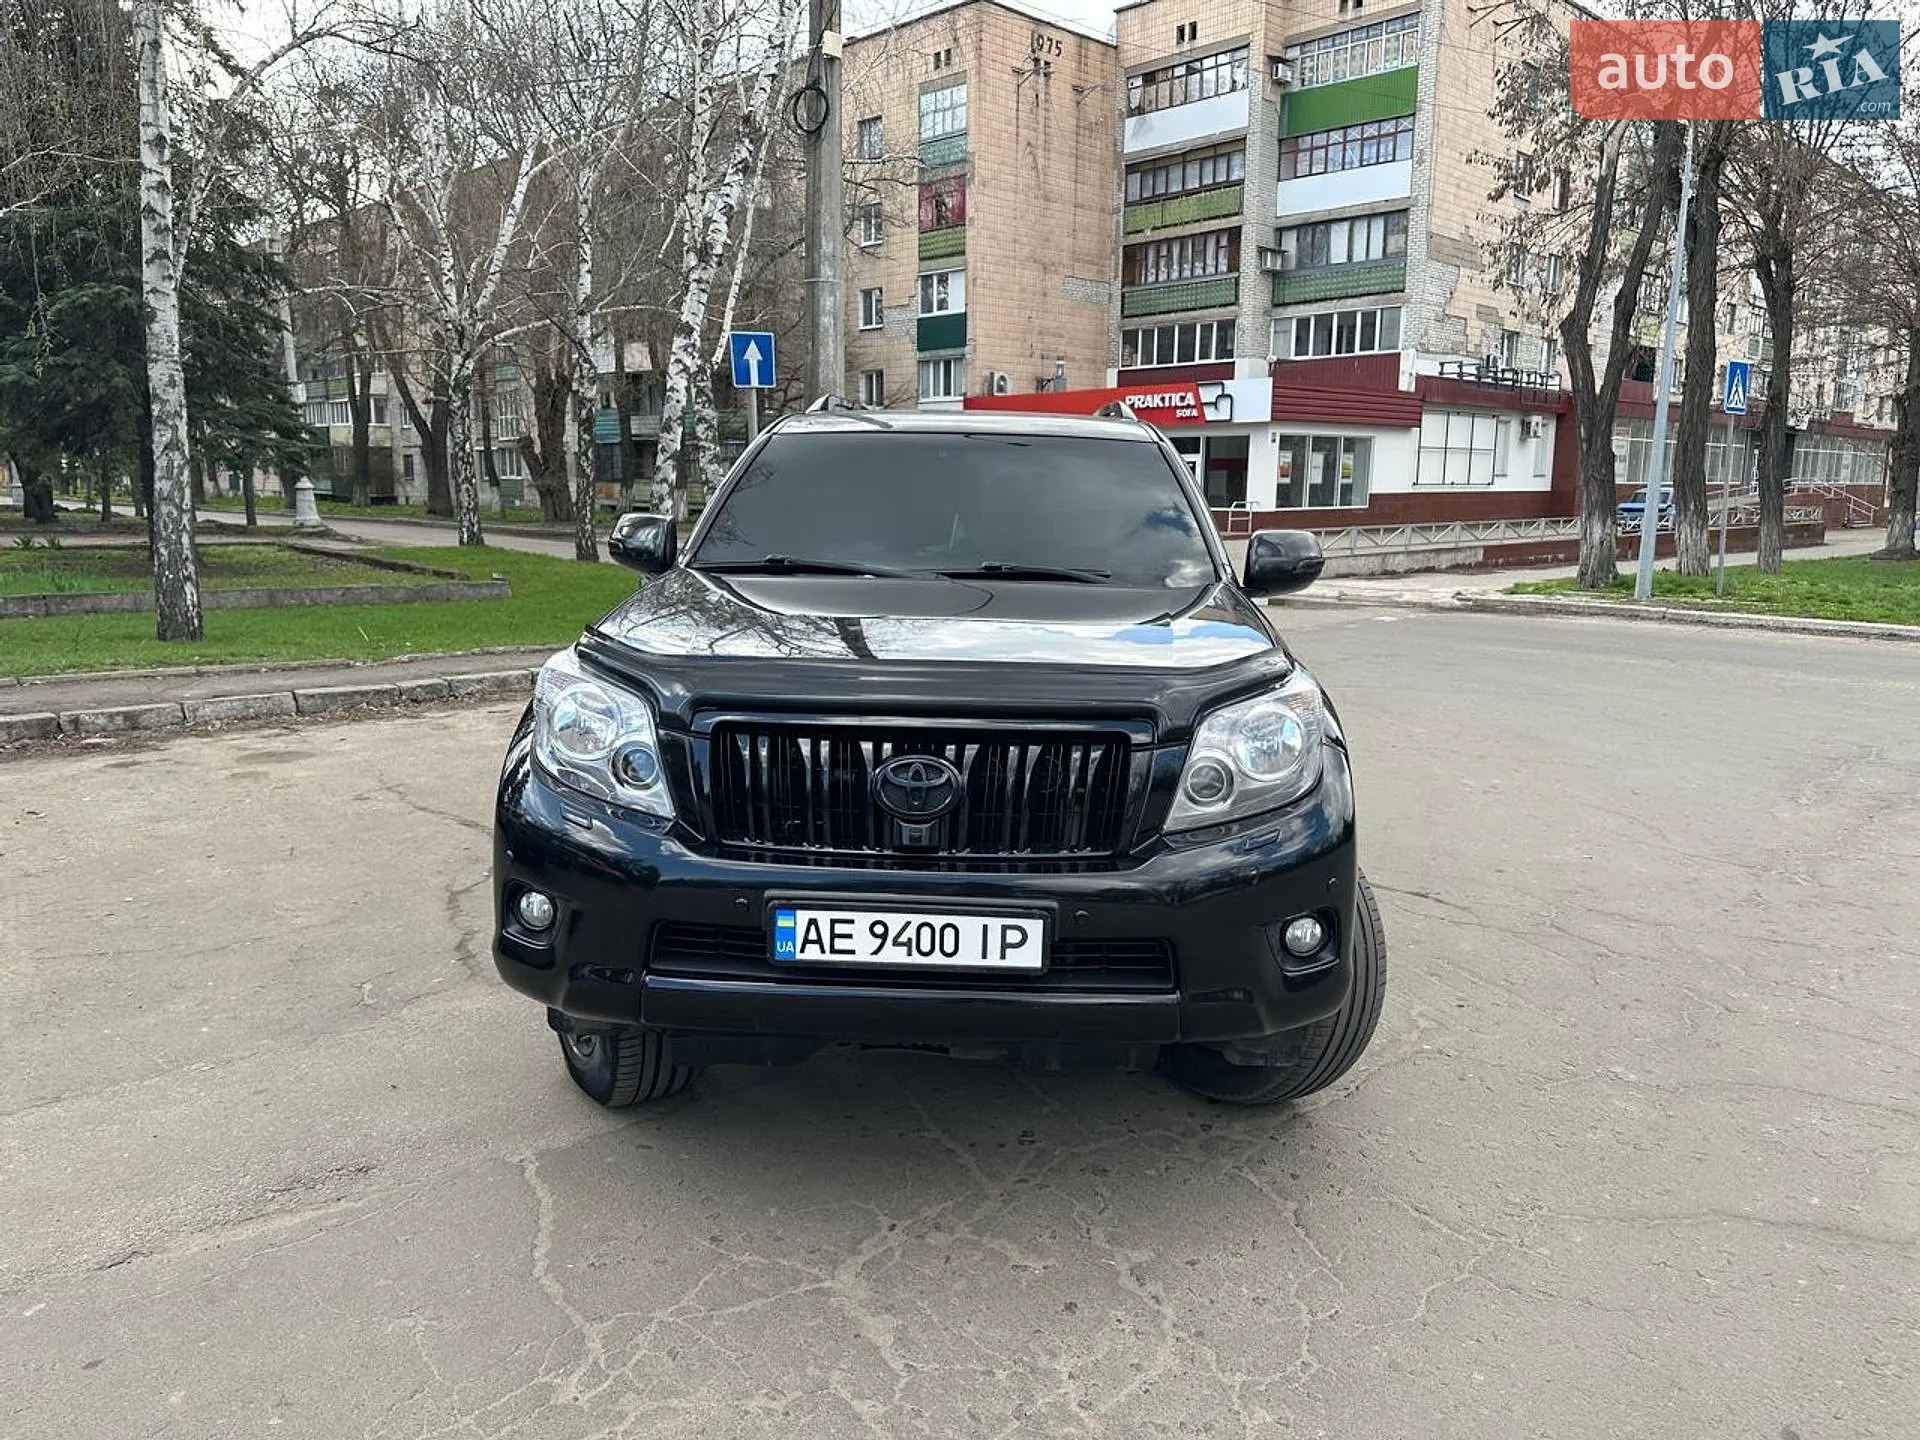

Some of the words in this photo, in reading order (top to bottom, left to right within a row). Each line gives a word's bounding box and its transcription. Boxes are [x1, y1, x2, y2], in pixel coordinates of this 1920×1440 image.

[1125, 392, 1196, 408] PRAKTICA
[1176, 408, 1198, 418] SOFA
[799, 917, 856, 954] AE
[868, 919, 960, 958] 9400
[981, 923, 1029, 960] IP
[777, 942, 795, 953] UA
